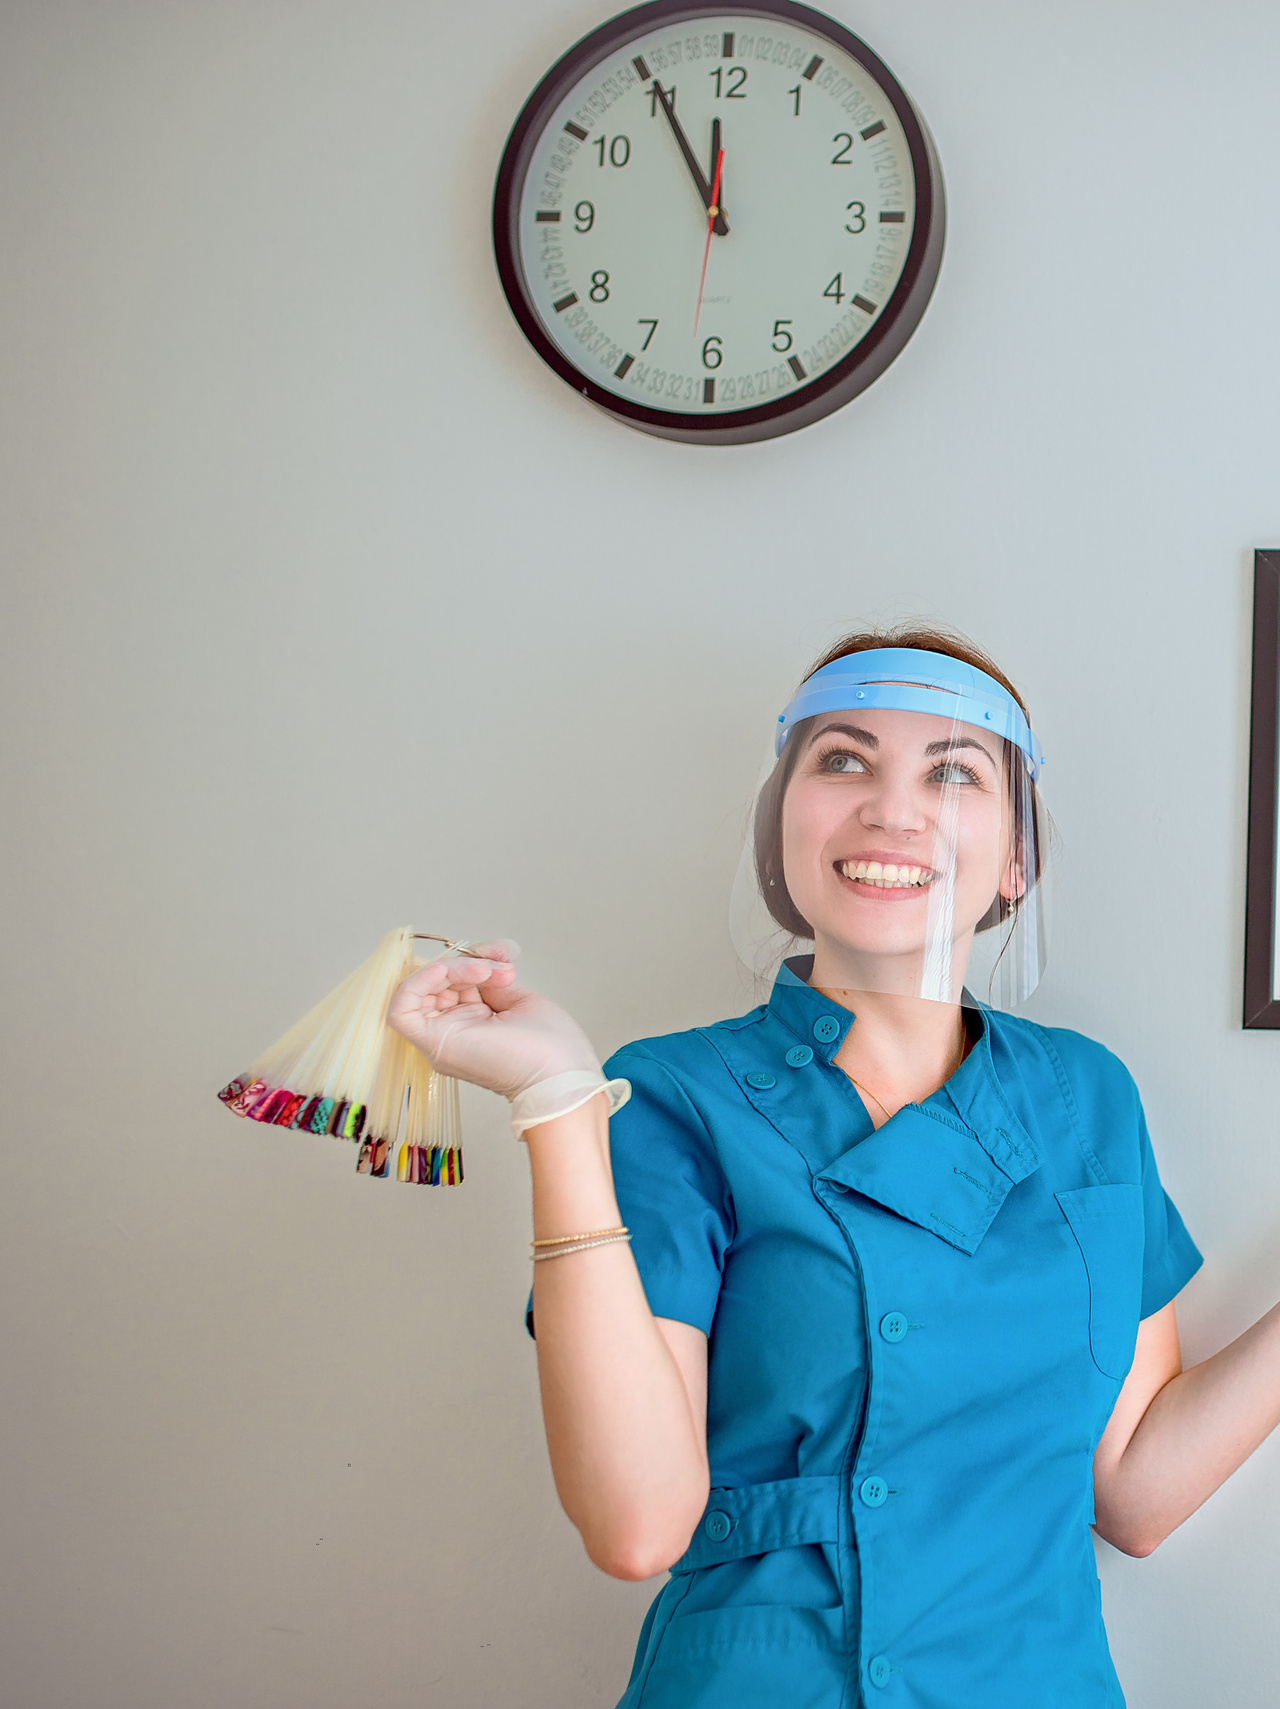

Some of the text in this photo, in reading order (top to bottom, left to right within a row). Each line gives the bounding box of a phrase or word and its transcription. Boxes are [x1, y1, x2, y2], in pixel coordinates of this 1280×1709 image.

[709, 66, 748, 98] 12
[645, 85, 677, 117] 11
[788, 84, 801, 116] 1
[592, 134, 631, 168] 10
[831, 132, 854, 165] 2
[574, 200, 595, 233] 9
[845, 201, 866, 234] 3
[589, 270, 610, 303] 8
[822, 272, 845, 304] 4
[637, 319, 660, 352] 7
[771, 320, 794, 352] 5
[702, 336, 723, 370] 6
